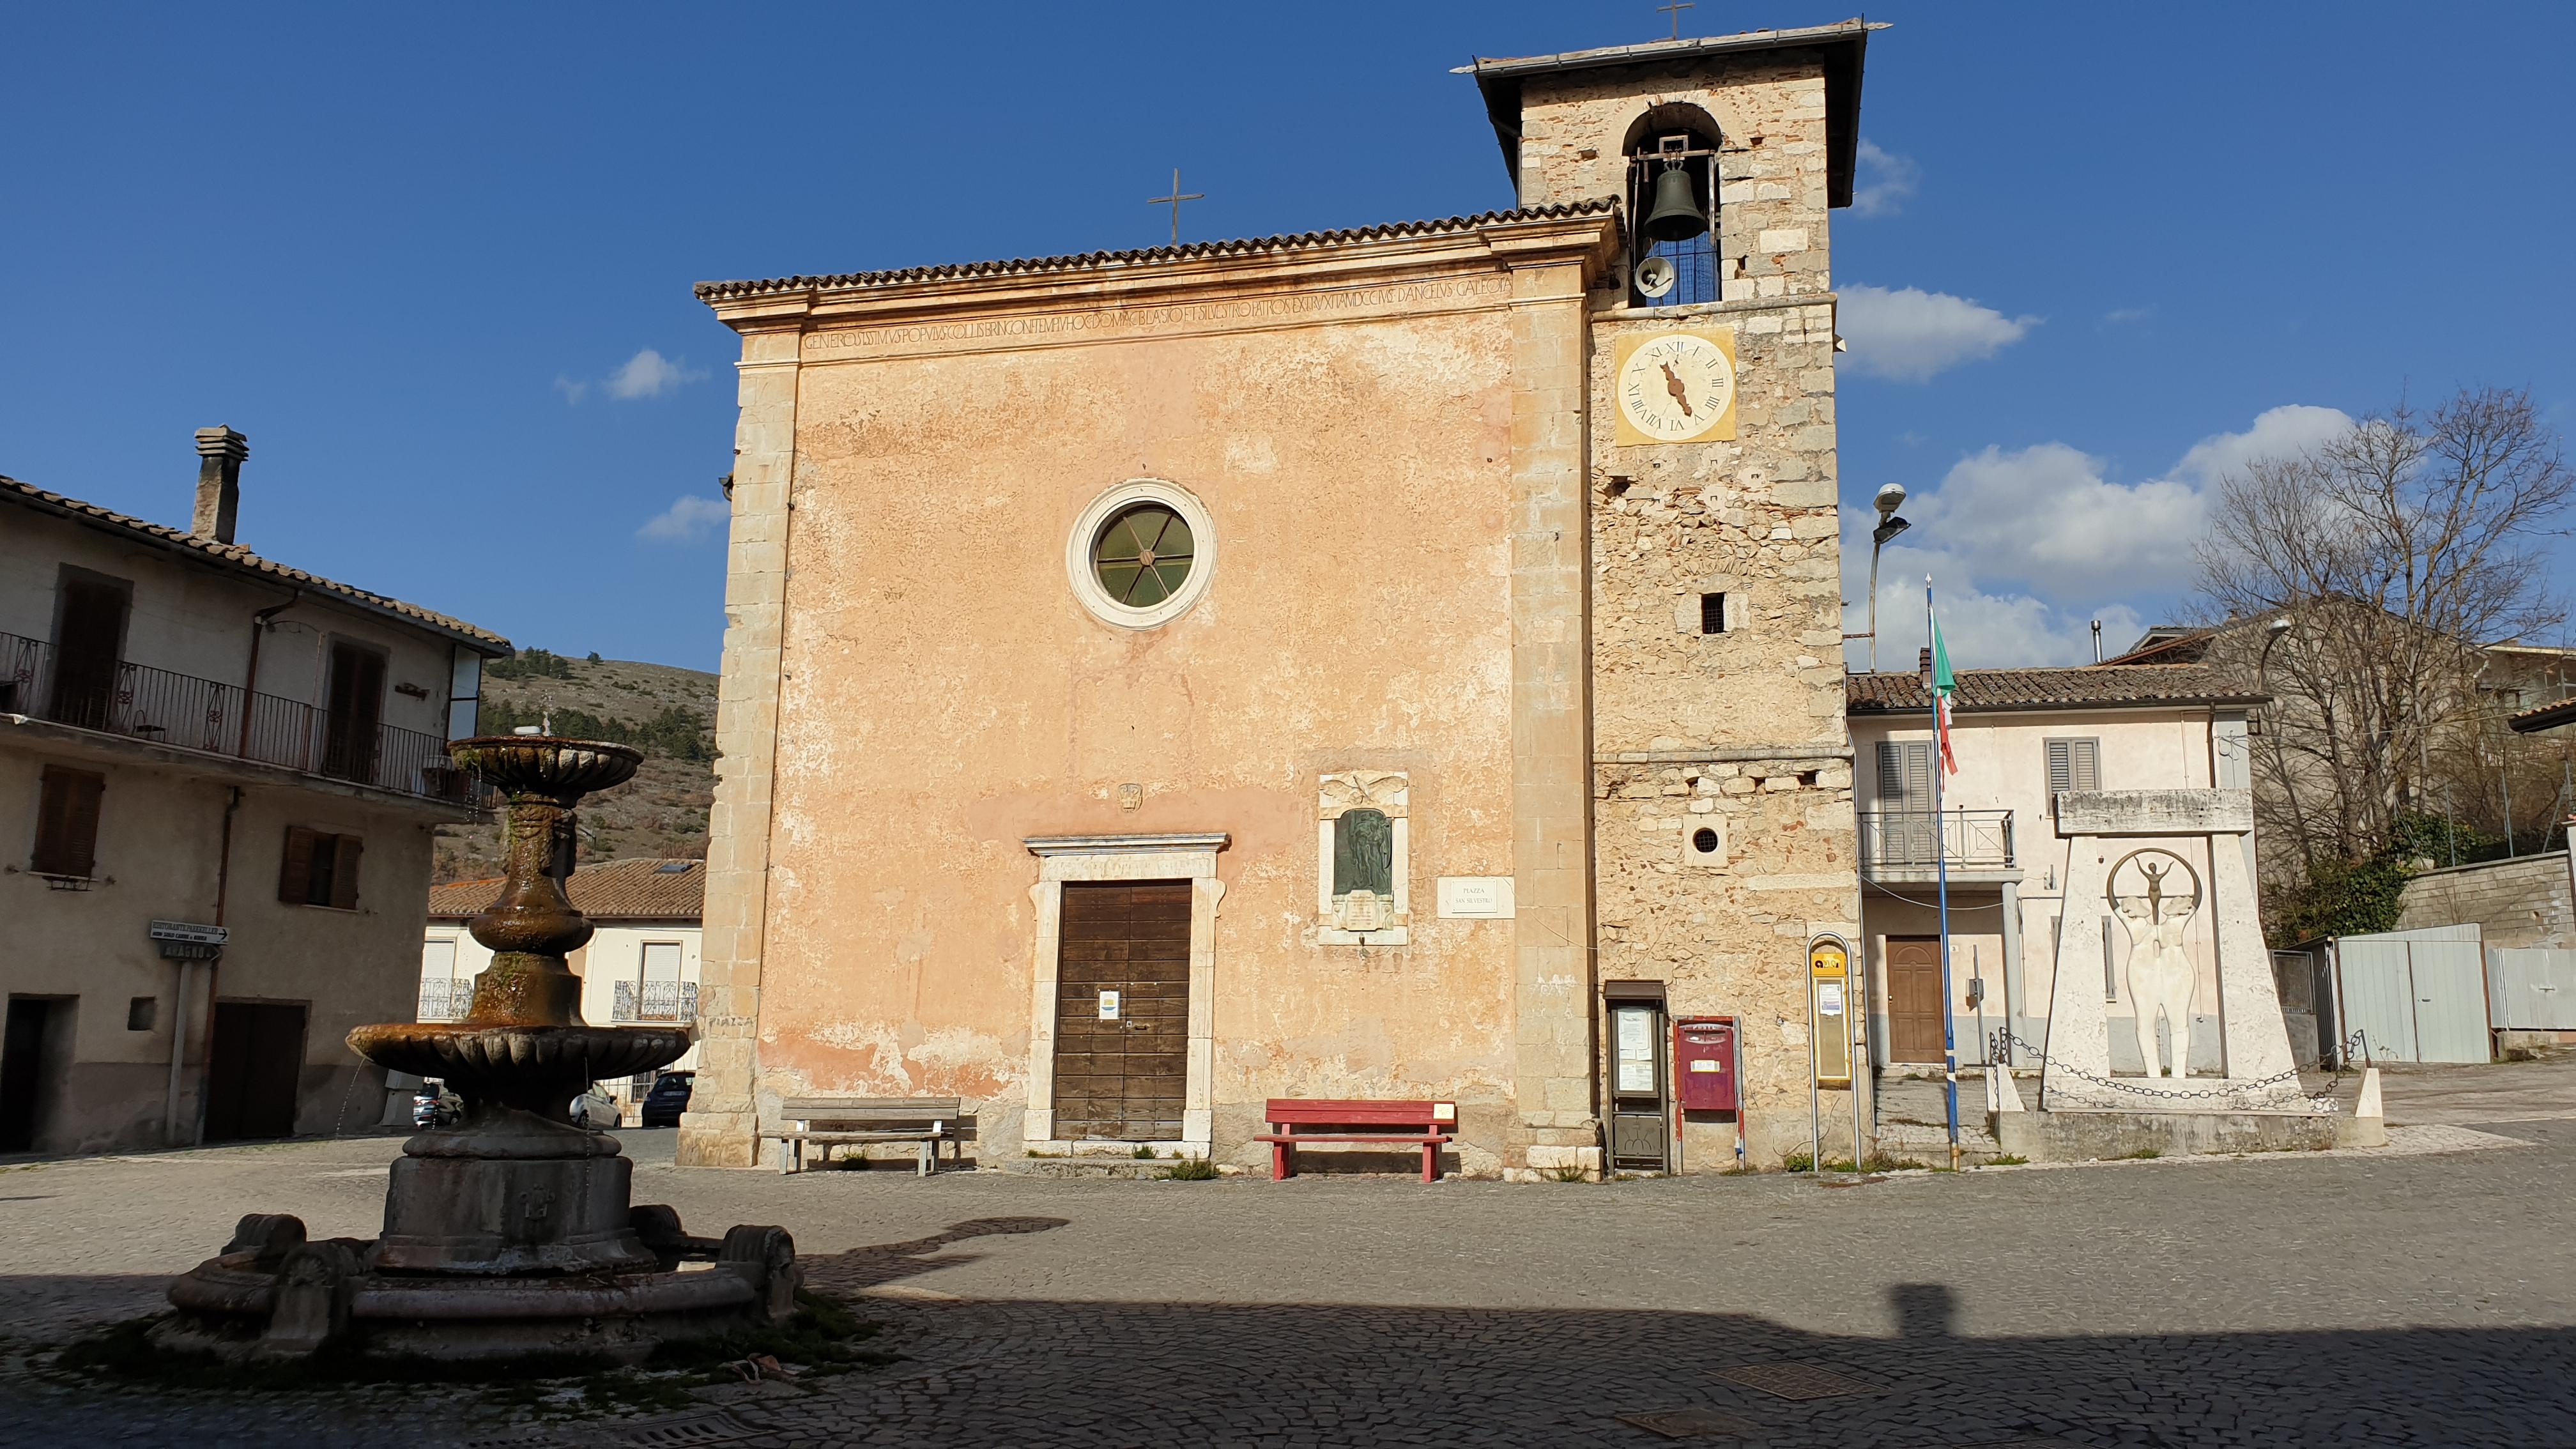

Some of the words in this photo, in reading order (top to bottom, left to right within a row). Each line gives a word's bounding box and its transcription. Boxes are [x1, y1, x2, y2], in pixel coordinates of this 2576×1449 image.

[1666, 341, 1683, 351] XII
[1692, 346, 1699, 358] I
[1631, 363, 1645, 373] X
[1705, 358, 1717, 369] II
[1712, 378, 1724, 387] III
[1628, 382, 1640, 396] IX
[1631, 399, 1648, 419] VIII
[1705, 396, 1720, 411] IIII
[1646, 414, 1662, 429] VII
[1670, 419, 1684, 431] VI
[1694, 414, 1705, 425] V
